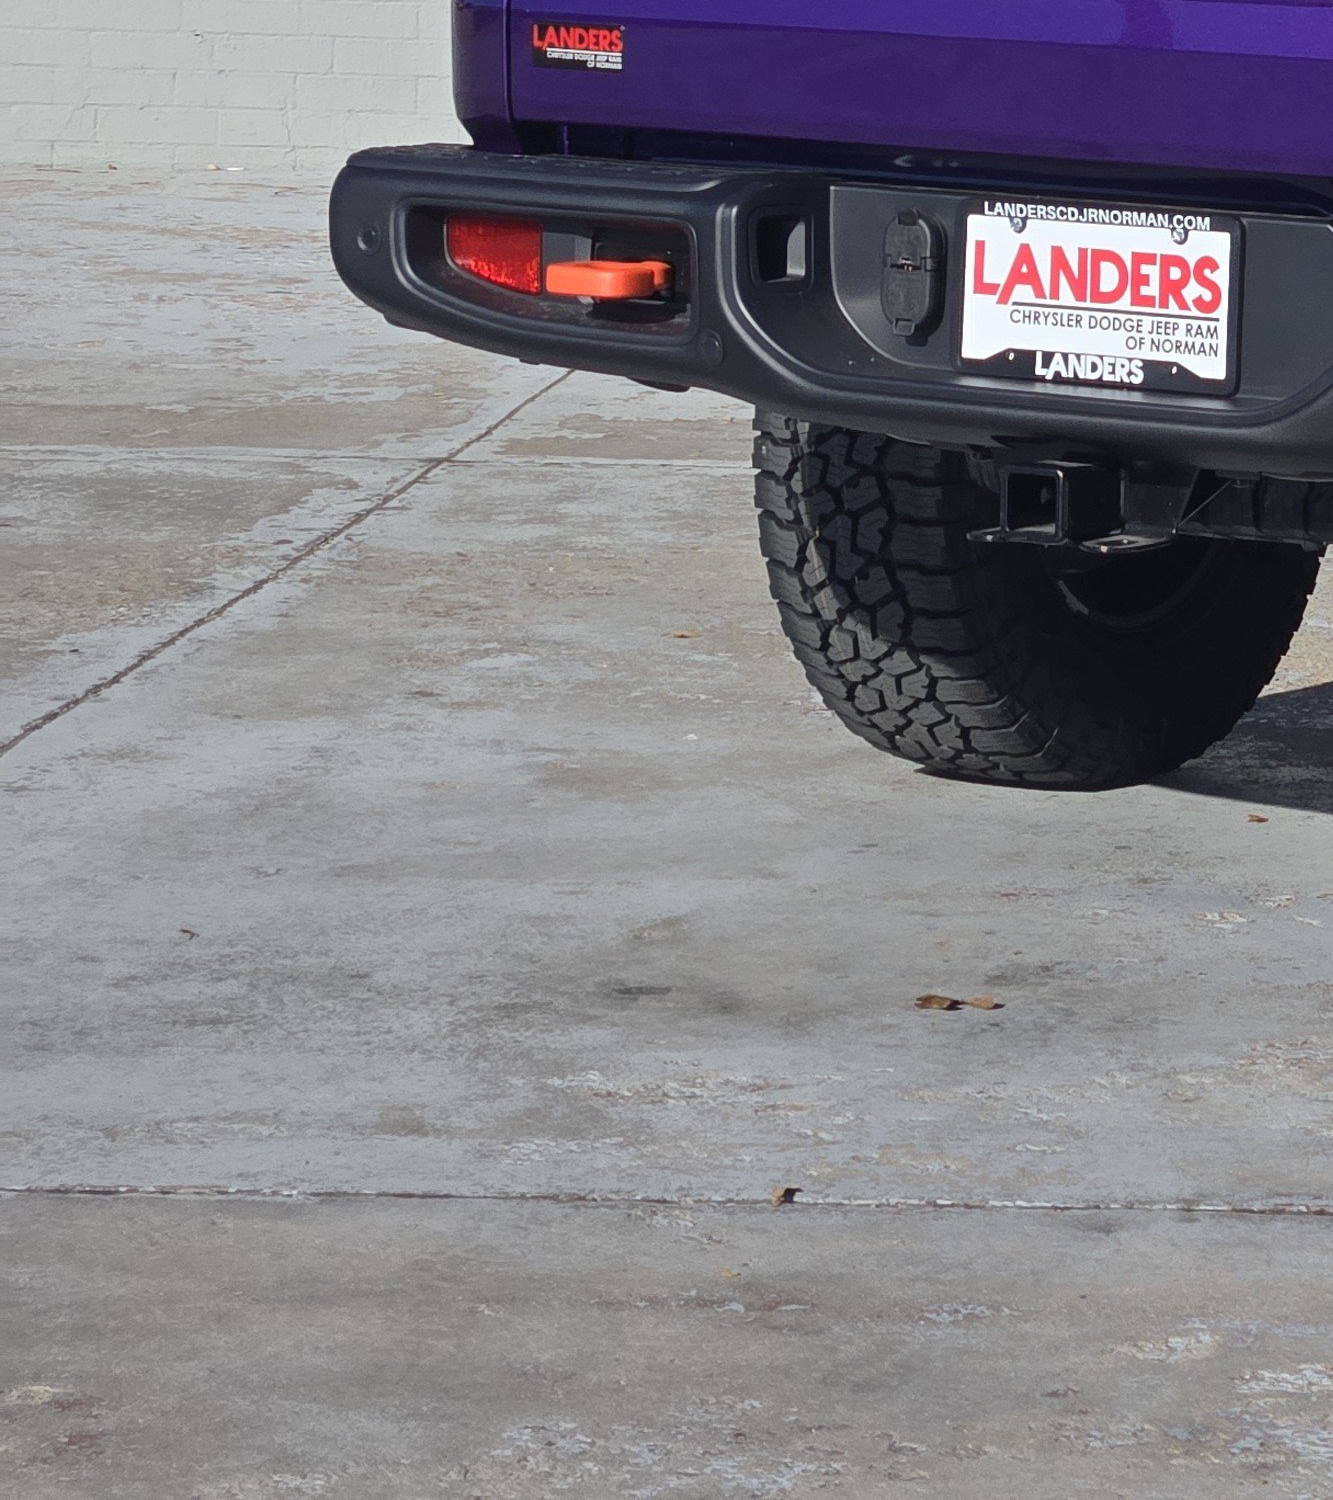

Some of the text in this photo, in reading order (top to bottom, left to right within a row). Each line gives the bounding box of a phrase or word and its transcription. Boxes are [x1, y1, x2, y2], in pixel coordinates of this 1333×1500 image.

[532, 23, 624, 52] LANDERS
[983, 201, 1211, 231] LANDERSCDJRNORMAN.COM
[973, 240, 1222, 314] LANDERS
[1009, 308, 1219, 340] CHRYSLER DODGE JEEP RAM
[1125, 335, 1219, 358] OF NORMAN
[1034, 350, 1144, 385] LANDERS
